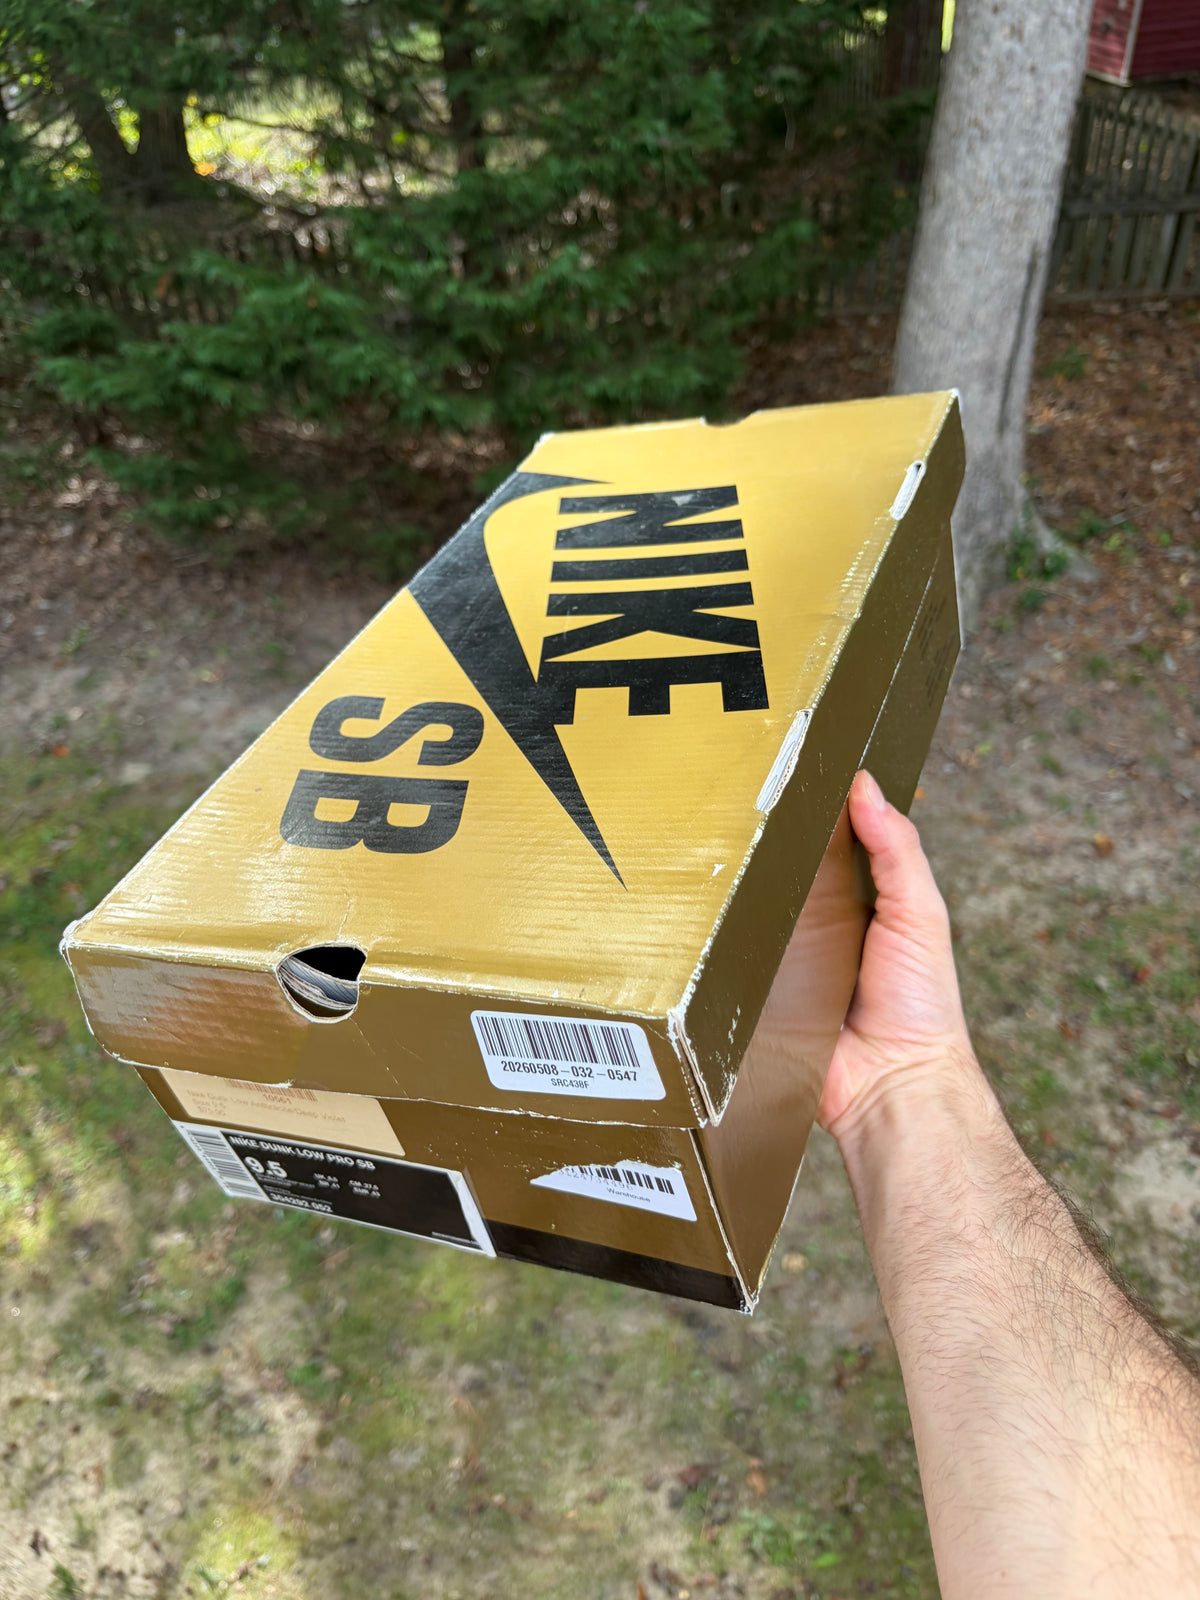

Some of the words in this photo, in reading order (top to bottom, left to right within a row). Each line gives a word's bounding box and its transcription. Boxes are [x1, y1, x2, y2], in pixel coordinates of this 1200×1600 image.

[541, 484, 770, 724] NIKE
[279, 695, 485, 855] SB
[229, 1136, 260, 1150] NIKE
[258, 1141, 296, 1157] DUNK
[294, 1147, 325, 1161] LOW
[326, 1153, 355, 1168] PRO
[355, 1159, 376, 1171] SB
[244, 1156, 288, 1179] 9.5
